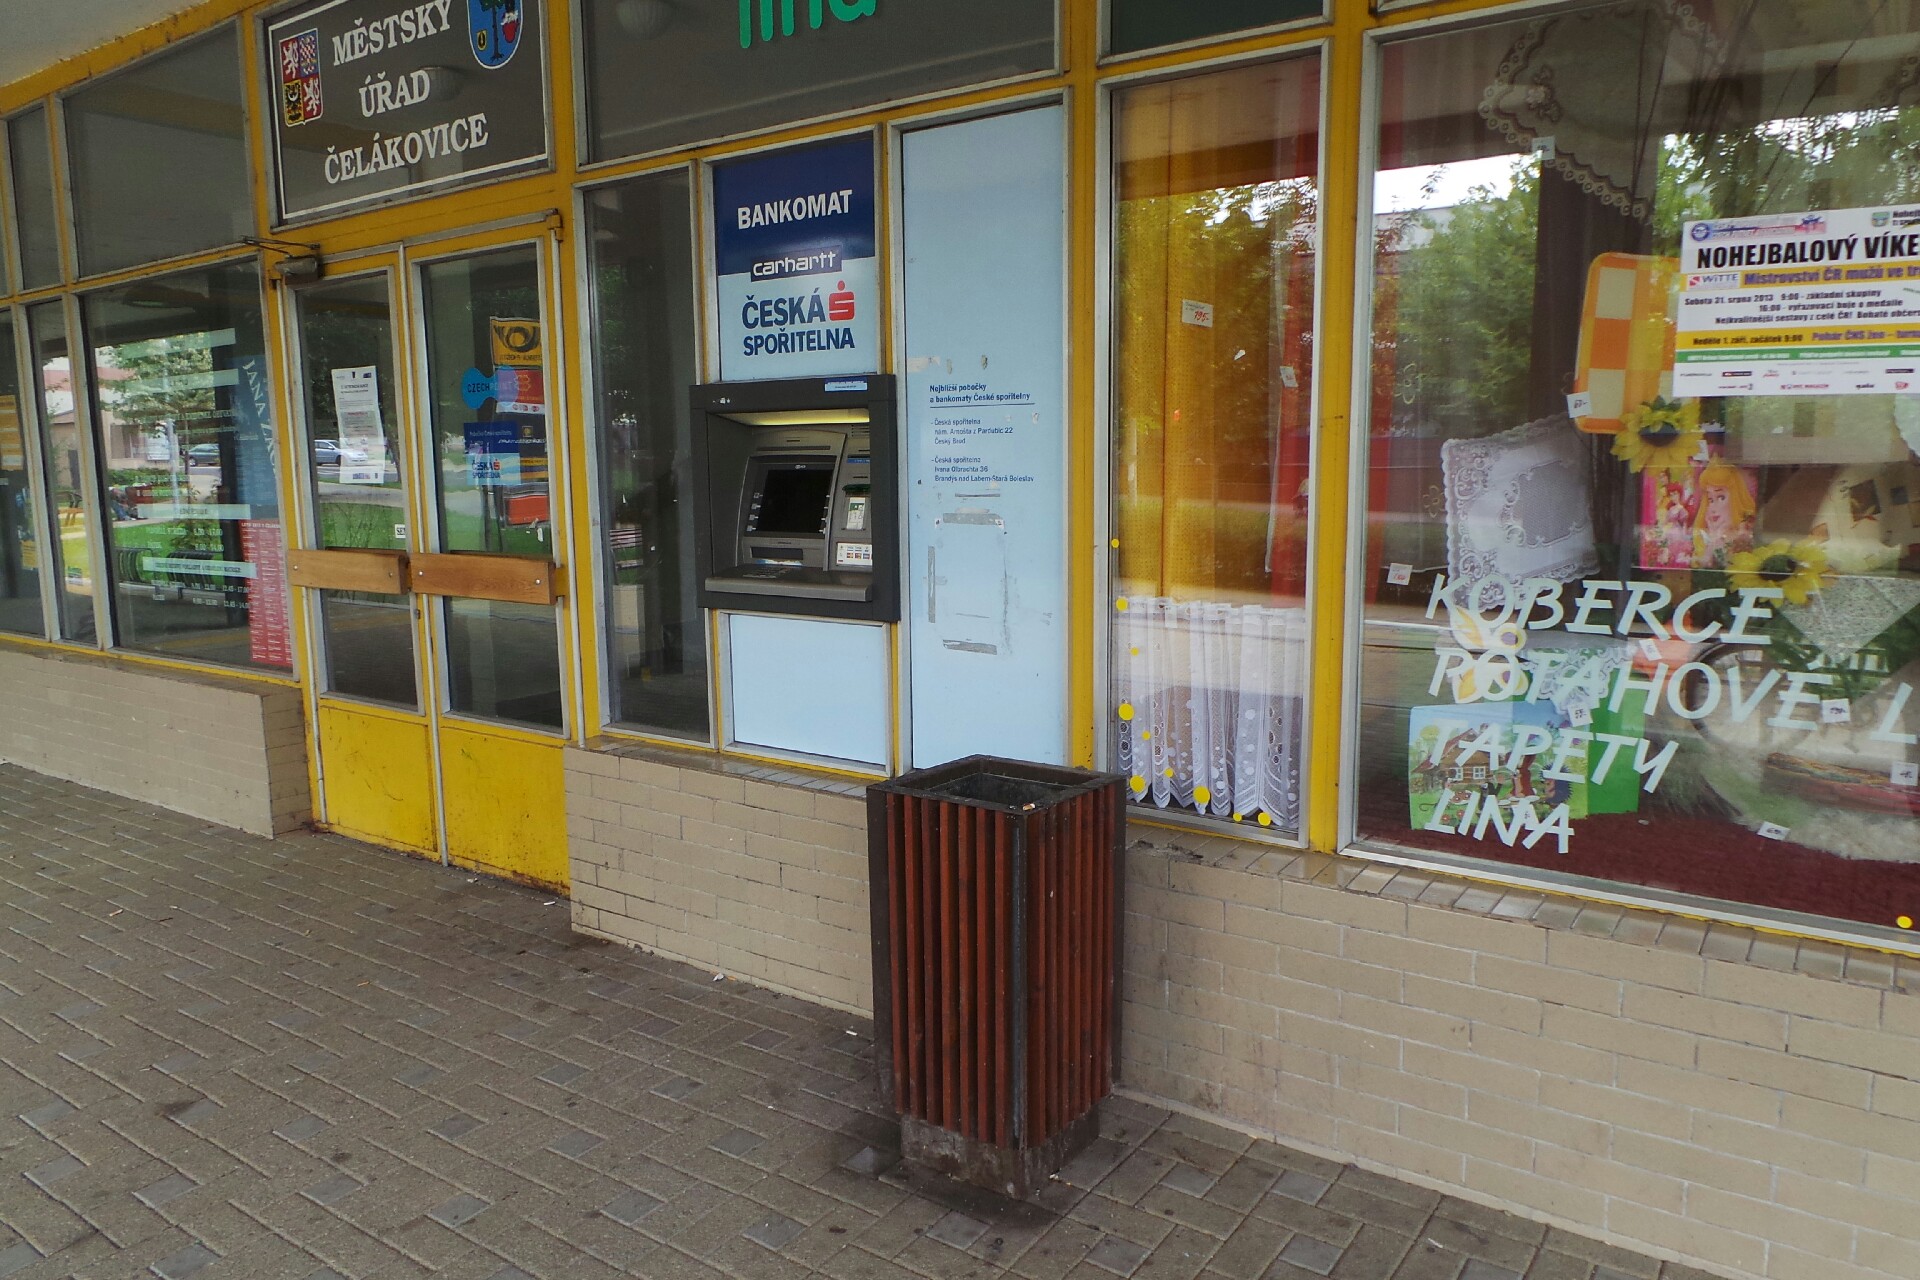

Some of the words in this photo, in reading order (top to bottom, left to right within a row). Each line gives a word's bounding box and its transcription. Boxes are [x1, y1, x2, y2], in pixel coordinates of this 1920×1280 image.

[359, 69, 431, 118] ÚŘAD
[325, 113, 489, 184] ČELÁKOVICE
[737, 189, 852, 230] BANKOMAT
[752, 250, 836, 277] carhartt
[1697, 233, 1858, 269] NOHEJBALOVÝ
[741, 287, 826, 329] ČESKÁ
[743, 327, 855, 357] SPOŘITELNA
[935, 394, 972, 404] bankomaty
[973, 392, 995, 401] České
[996, 391, 1031, 402] spořitelny
[958, 383, 987, 393] pobočky
[934, 417, 952, 426] Česká
[1004, 426, 1014, 434] 22
[934, 455, 952, 464] Česká
[1425, 573, 1784, 646] KOBERCE
[1429, 717, 1679, 795] TAPETY
